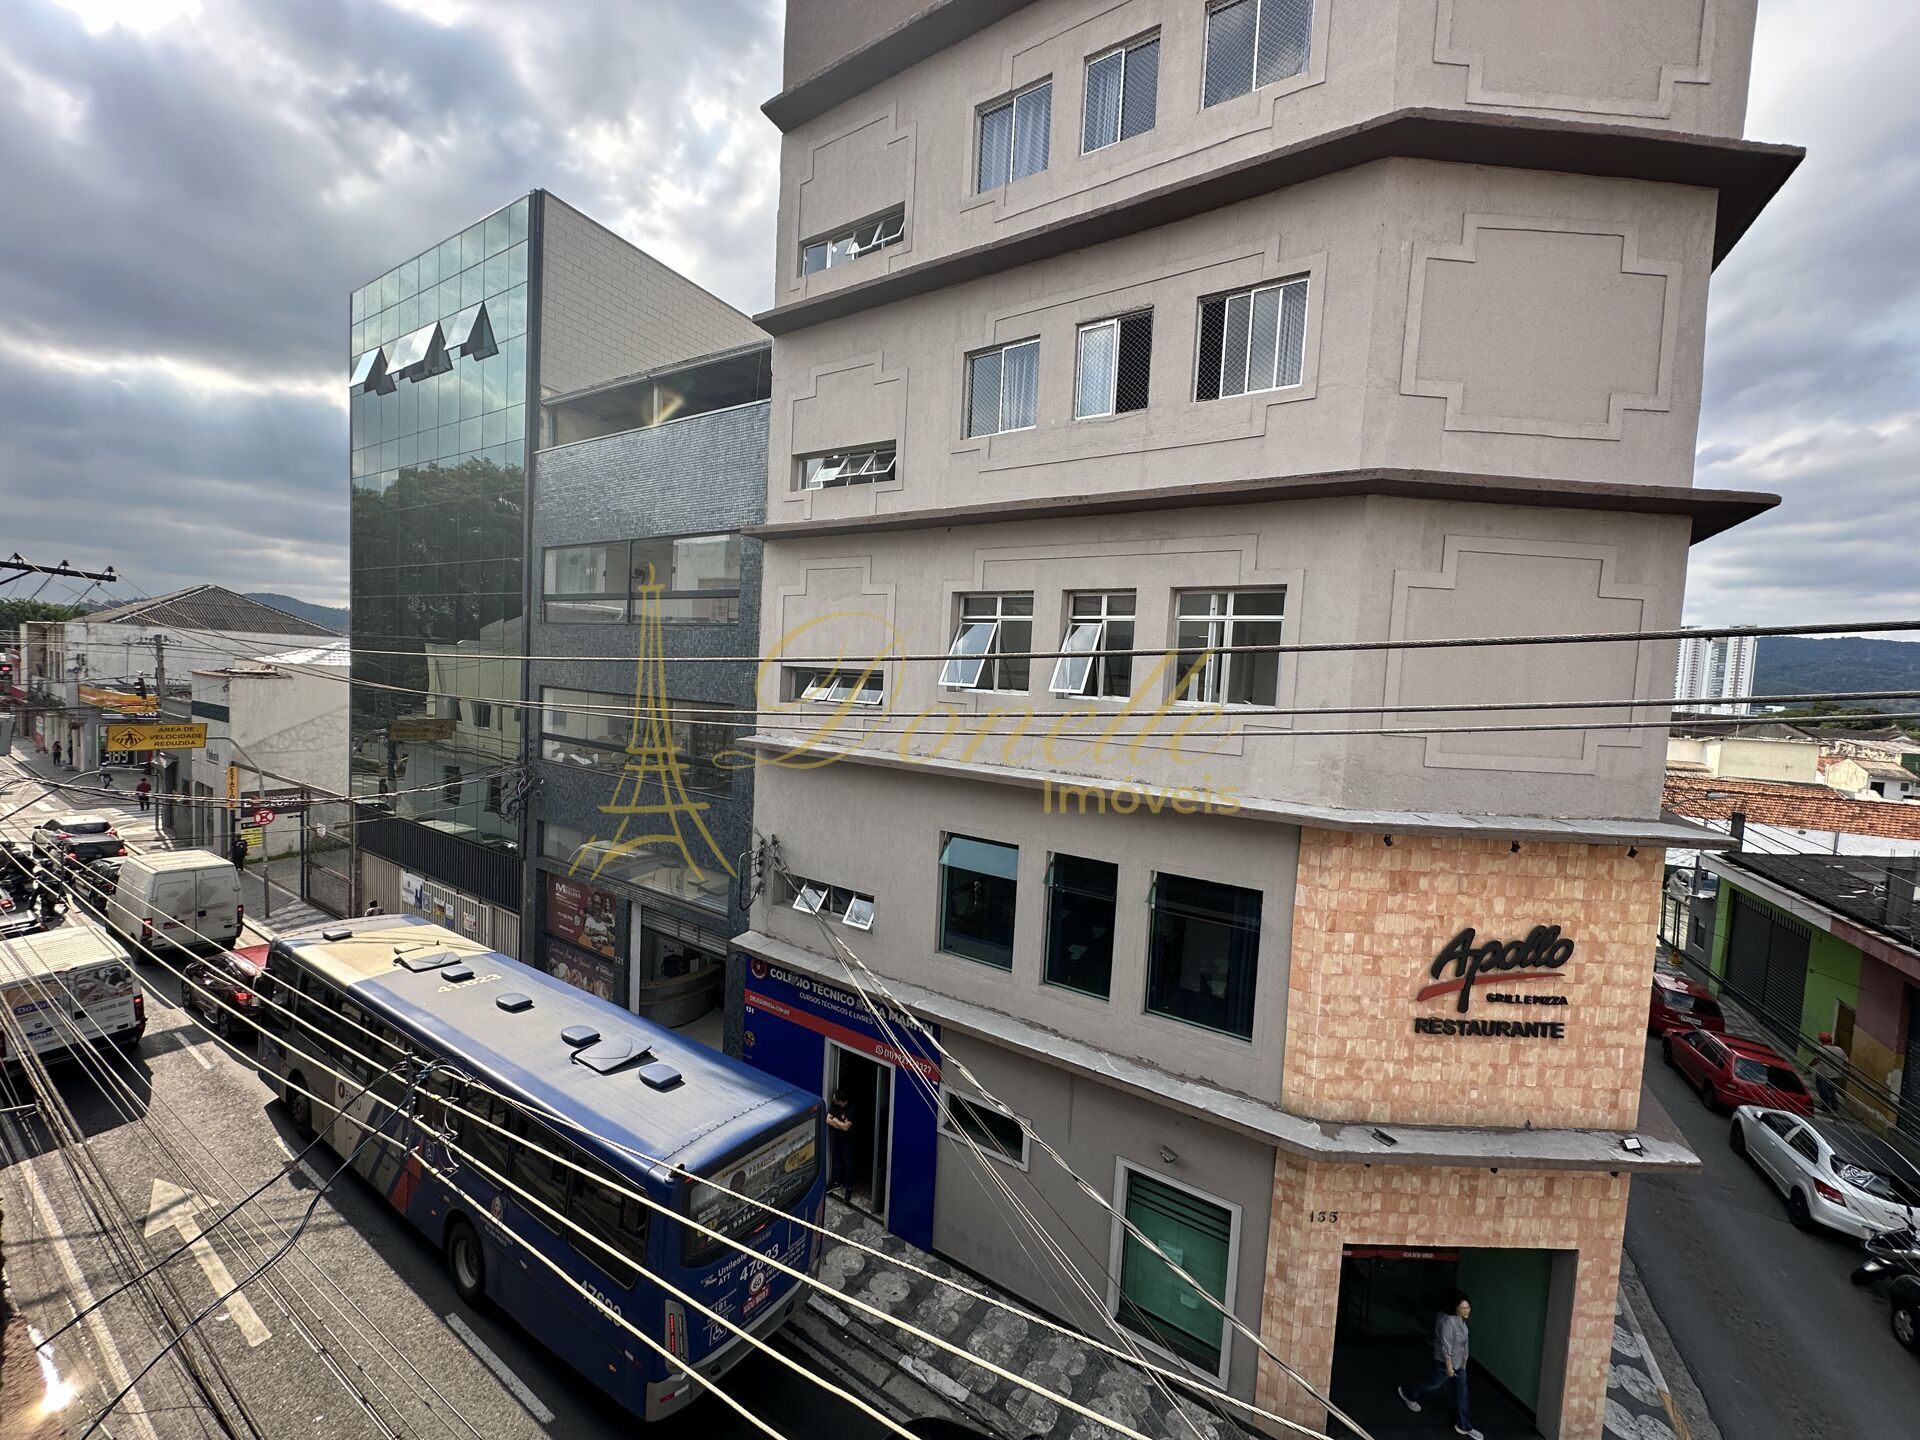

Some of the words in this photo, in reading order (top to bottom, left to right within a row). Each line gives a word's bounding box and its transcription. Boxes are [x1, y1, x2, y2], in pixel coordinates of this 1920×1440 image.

[1431, 925, 1574, 1013] Apollo
[799, 992, 821, 1005] CURSOS
[821, 1000, 848, 1016] TÉCNICOS
[848, 1010, 853, 1018] E
[853, 1012, 873, 1025] LIVRES
[811, 982, 855, 1007] TÉCNICO
[1414, 1017, 1565, 1039] RESTAURANTE
